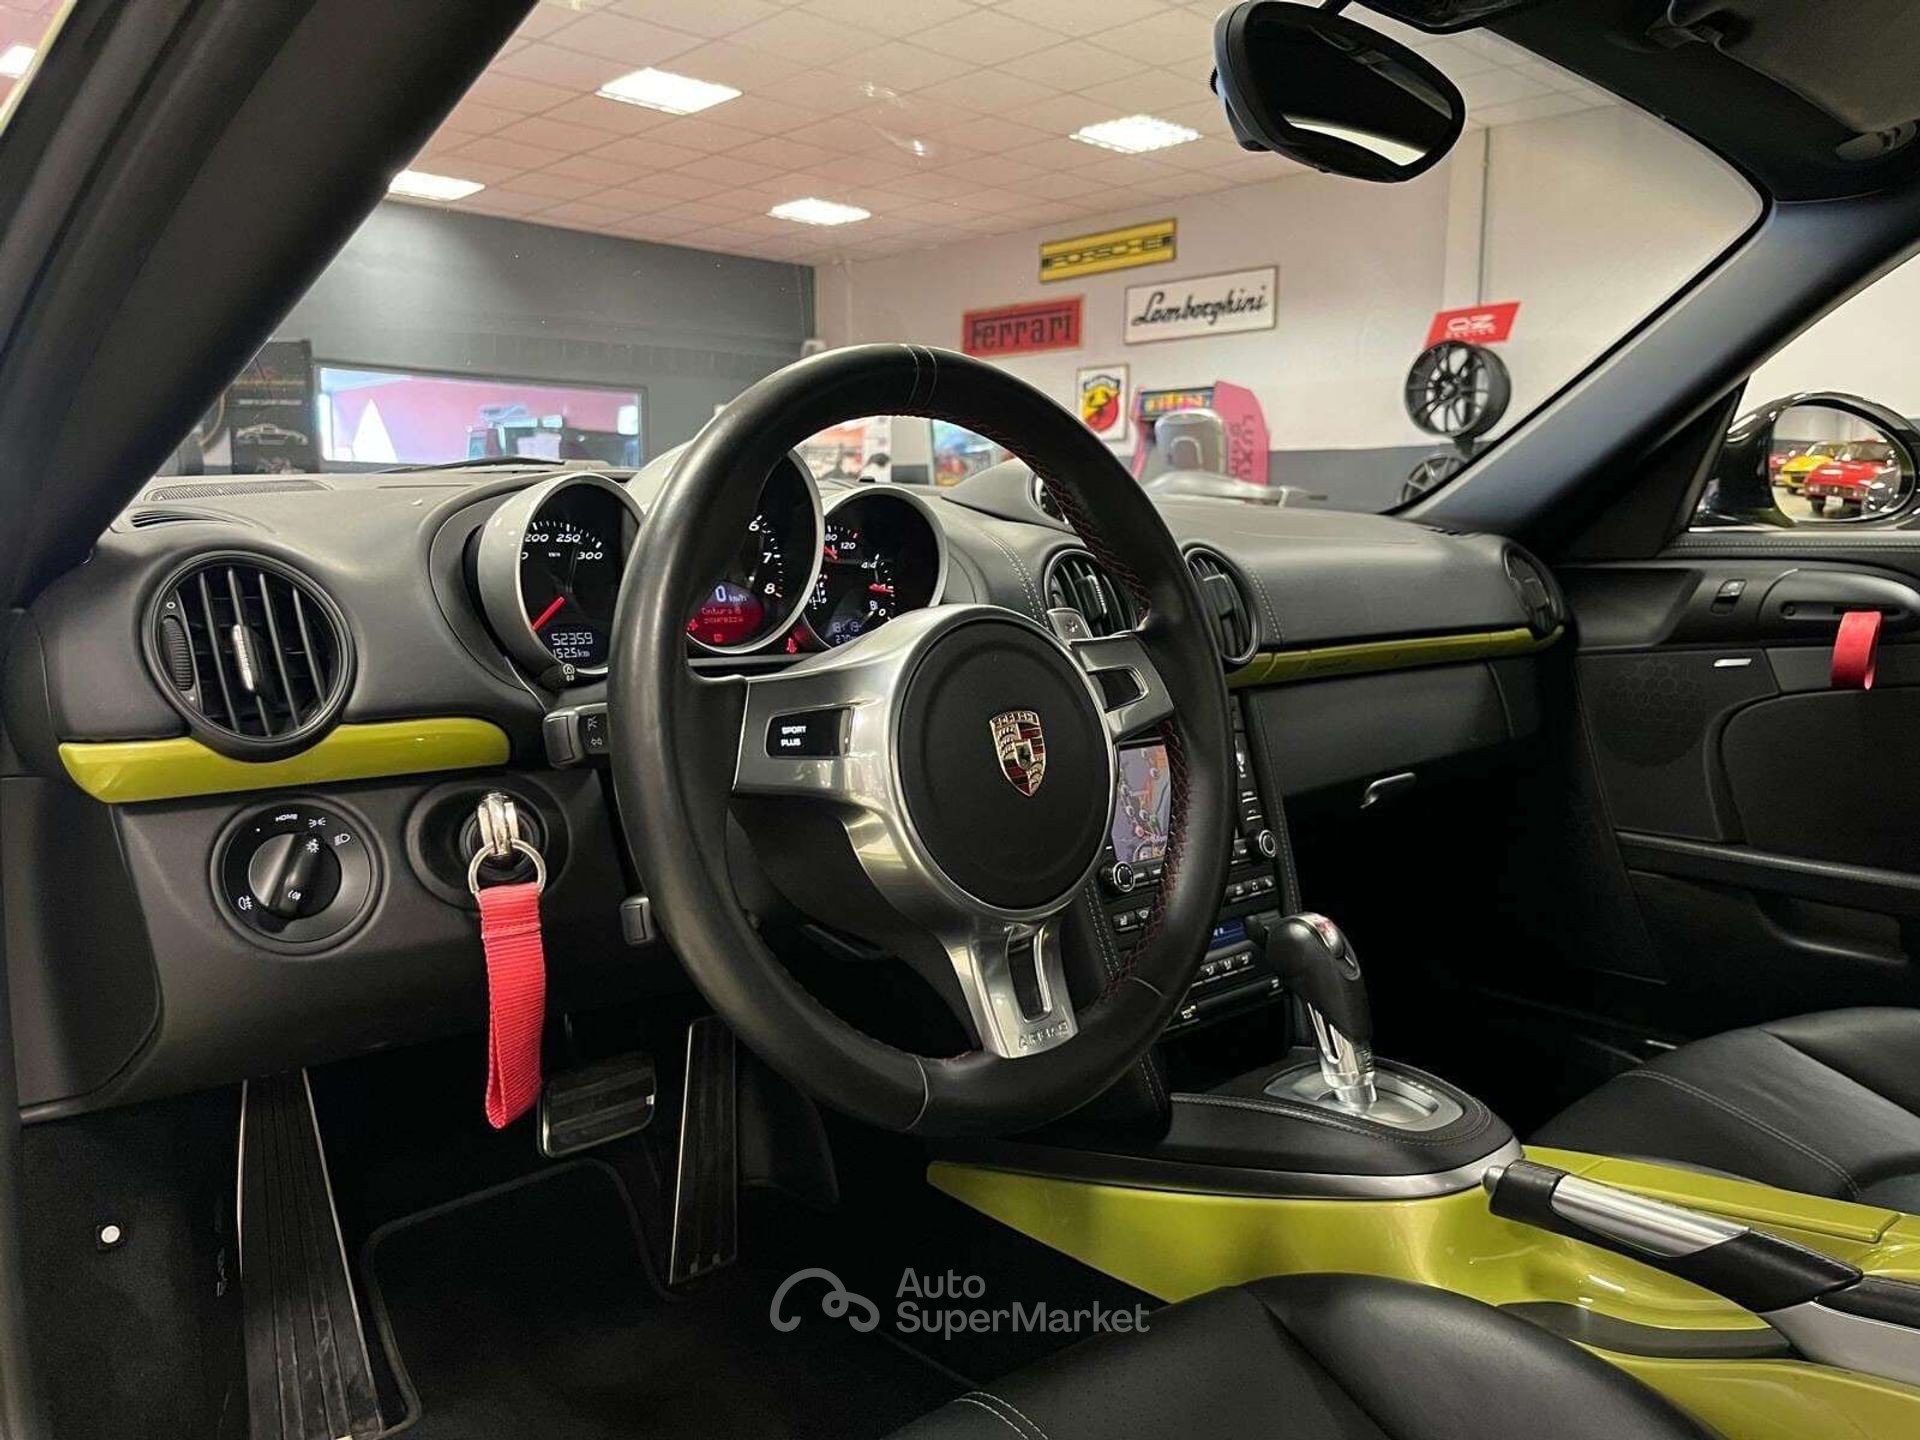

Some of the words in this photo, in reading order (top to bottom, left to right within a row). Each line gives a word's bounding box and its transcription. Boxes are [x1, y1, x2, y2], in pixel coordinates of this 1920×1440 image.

[1051, 236, 1164, 269] PORSCHE
[1131, 284, 1268, 327] Lamborghini
[971, 308, 1074, 350] Ferrari
[748, 521, 759, 531] 6
[524, 533, 550, 543] 200
[555, 533, 581, 543] 250
[840, 541, 856, 550] 120
[576, 551, 603, 561] 300
[763, 552, 772, 563] 7
[715, 585, 727, 602] 0
[764, 583, 775, 594] 8
[878, 608, 887, 617] 0
[551, 632, 594, 646] 52359
[781, 725, 807, 735] SPORT
[780, 738, 801, 747] PLUS
